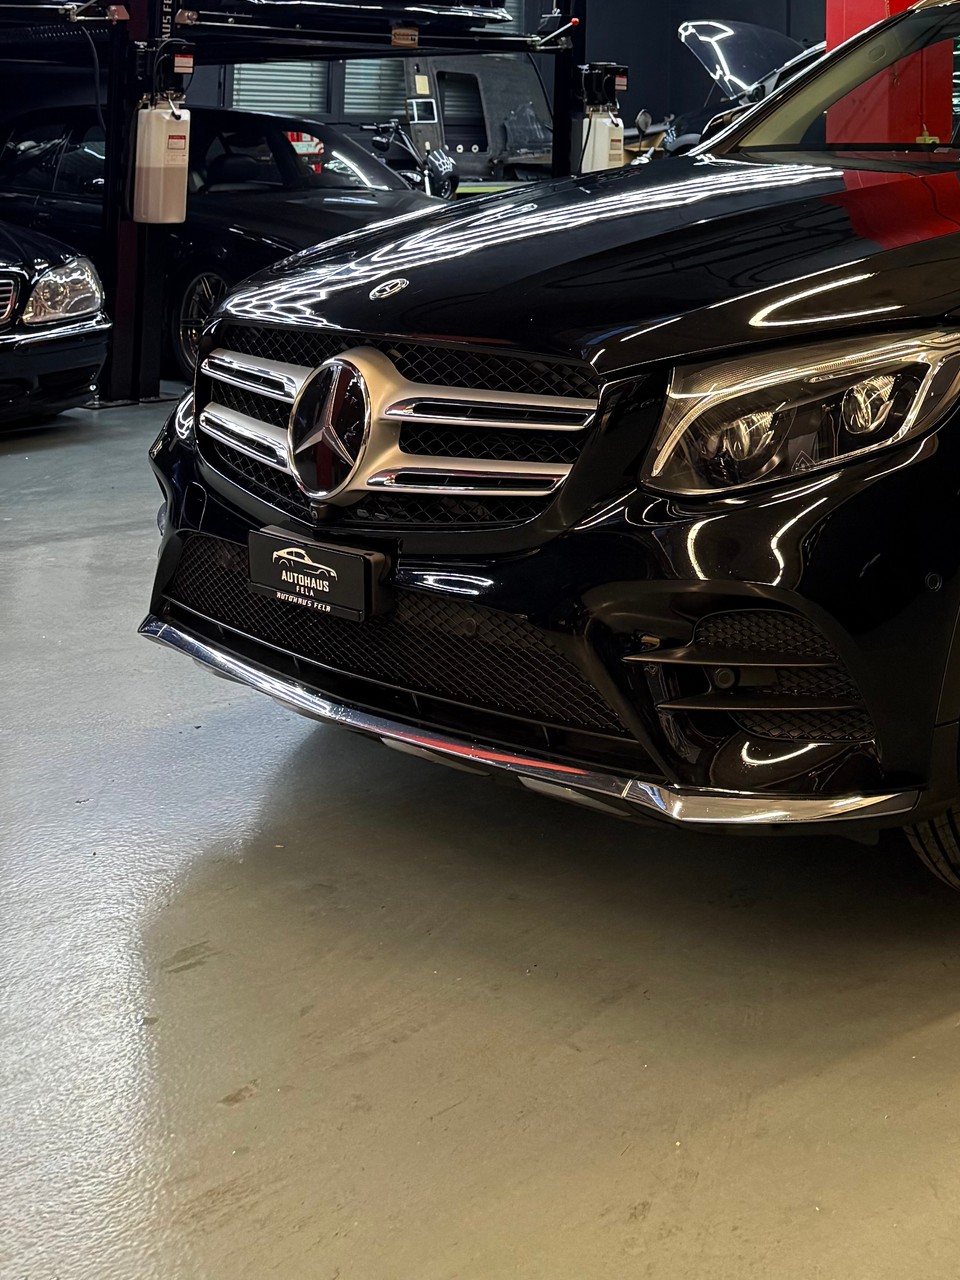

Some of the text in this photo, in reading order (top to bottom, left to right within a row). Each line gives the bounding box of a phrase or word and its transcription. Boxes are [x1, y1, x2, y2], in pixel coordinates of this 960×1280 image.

[281, 570, 330, 592] AUTOHAUS
[296, 585, 315, 597] FELA
[276, 592, 331, 613] AUTOHAUS FELA
